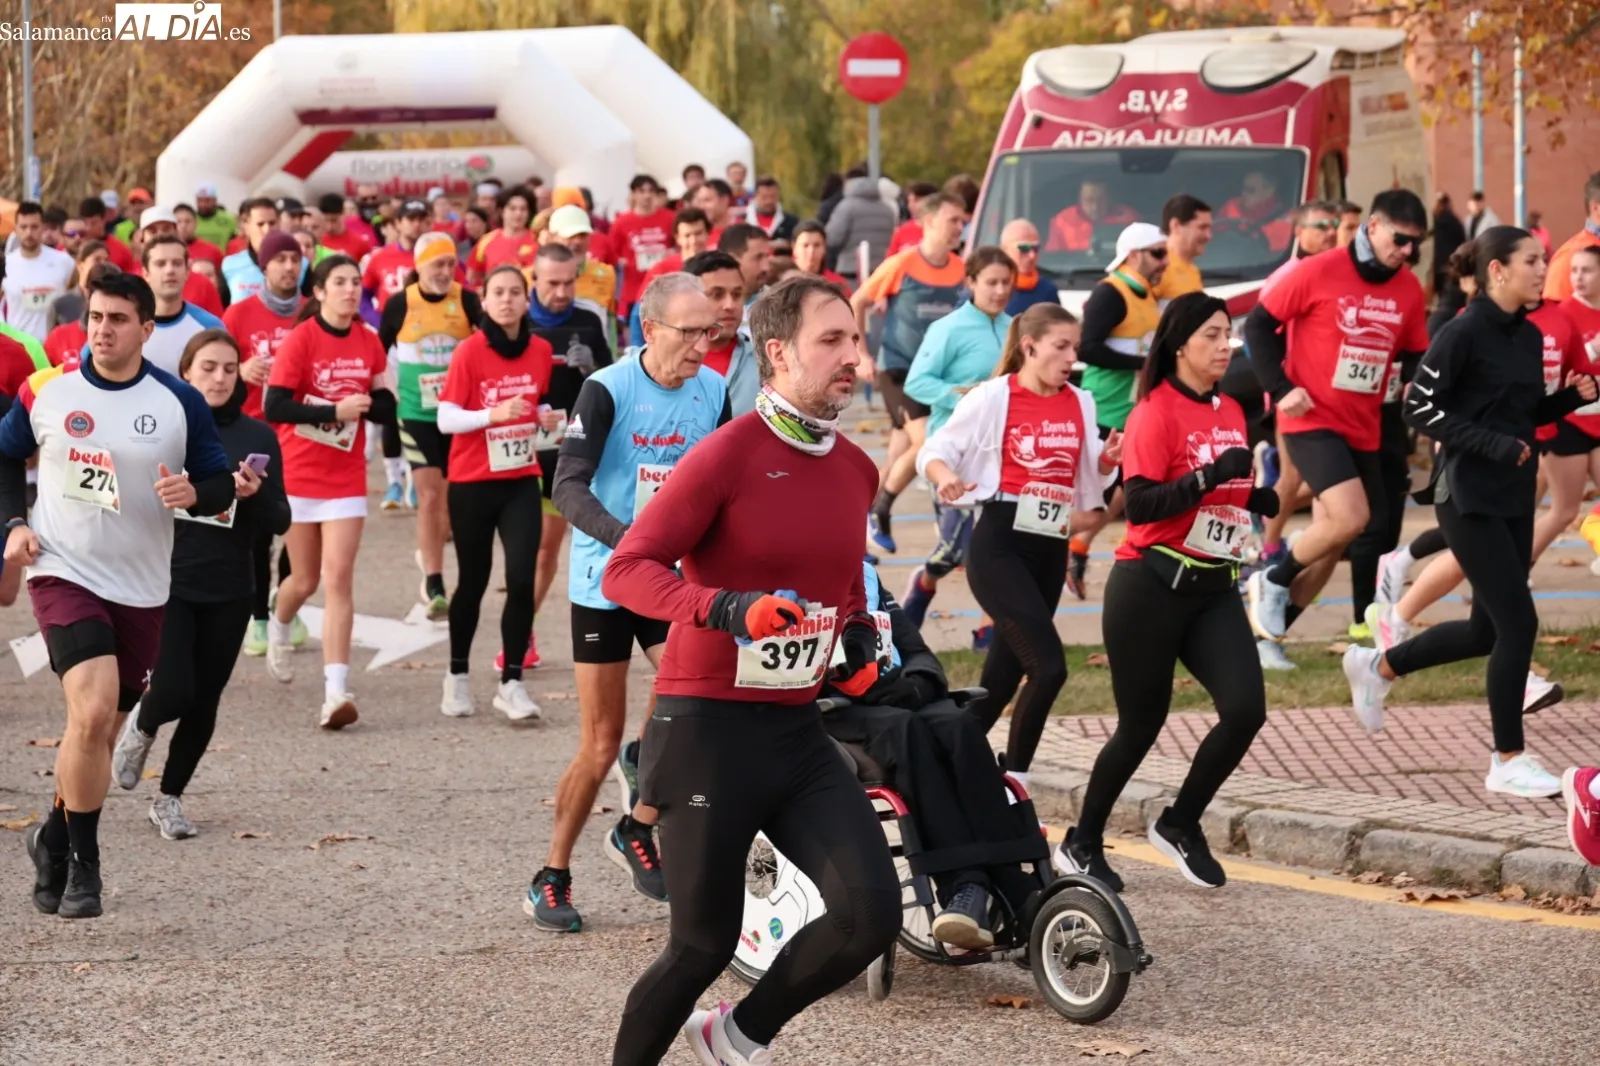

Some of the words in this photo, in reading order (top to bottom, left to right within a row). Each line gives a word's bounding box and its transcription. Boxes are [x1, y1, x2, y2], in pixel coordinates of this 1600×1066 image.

[1348, 363, 1377, 382] 341
[502, 440, 530, 458] 123
[1038, 500, 1062, 522] 57
[1206, 519, 1236, 544] 131
[760, 637, 820, 671] 397
